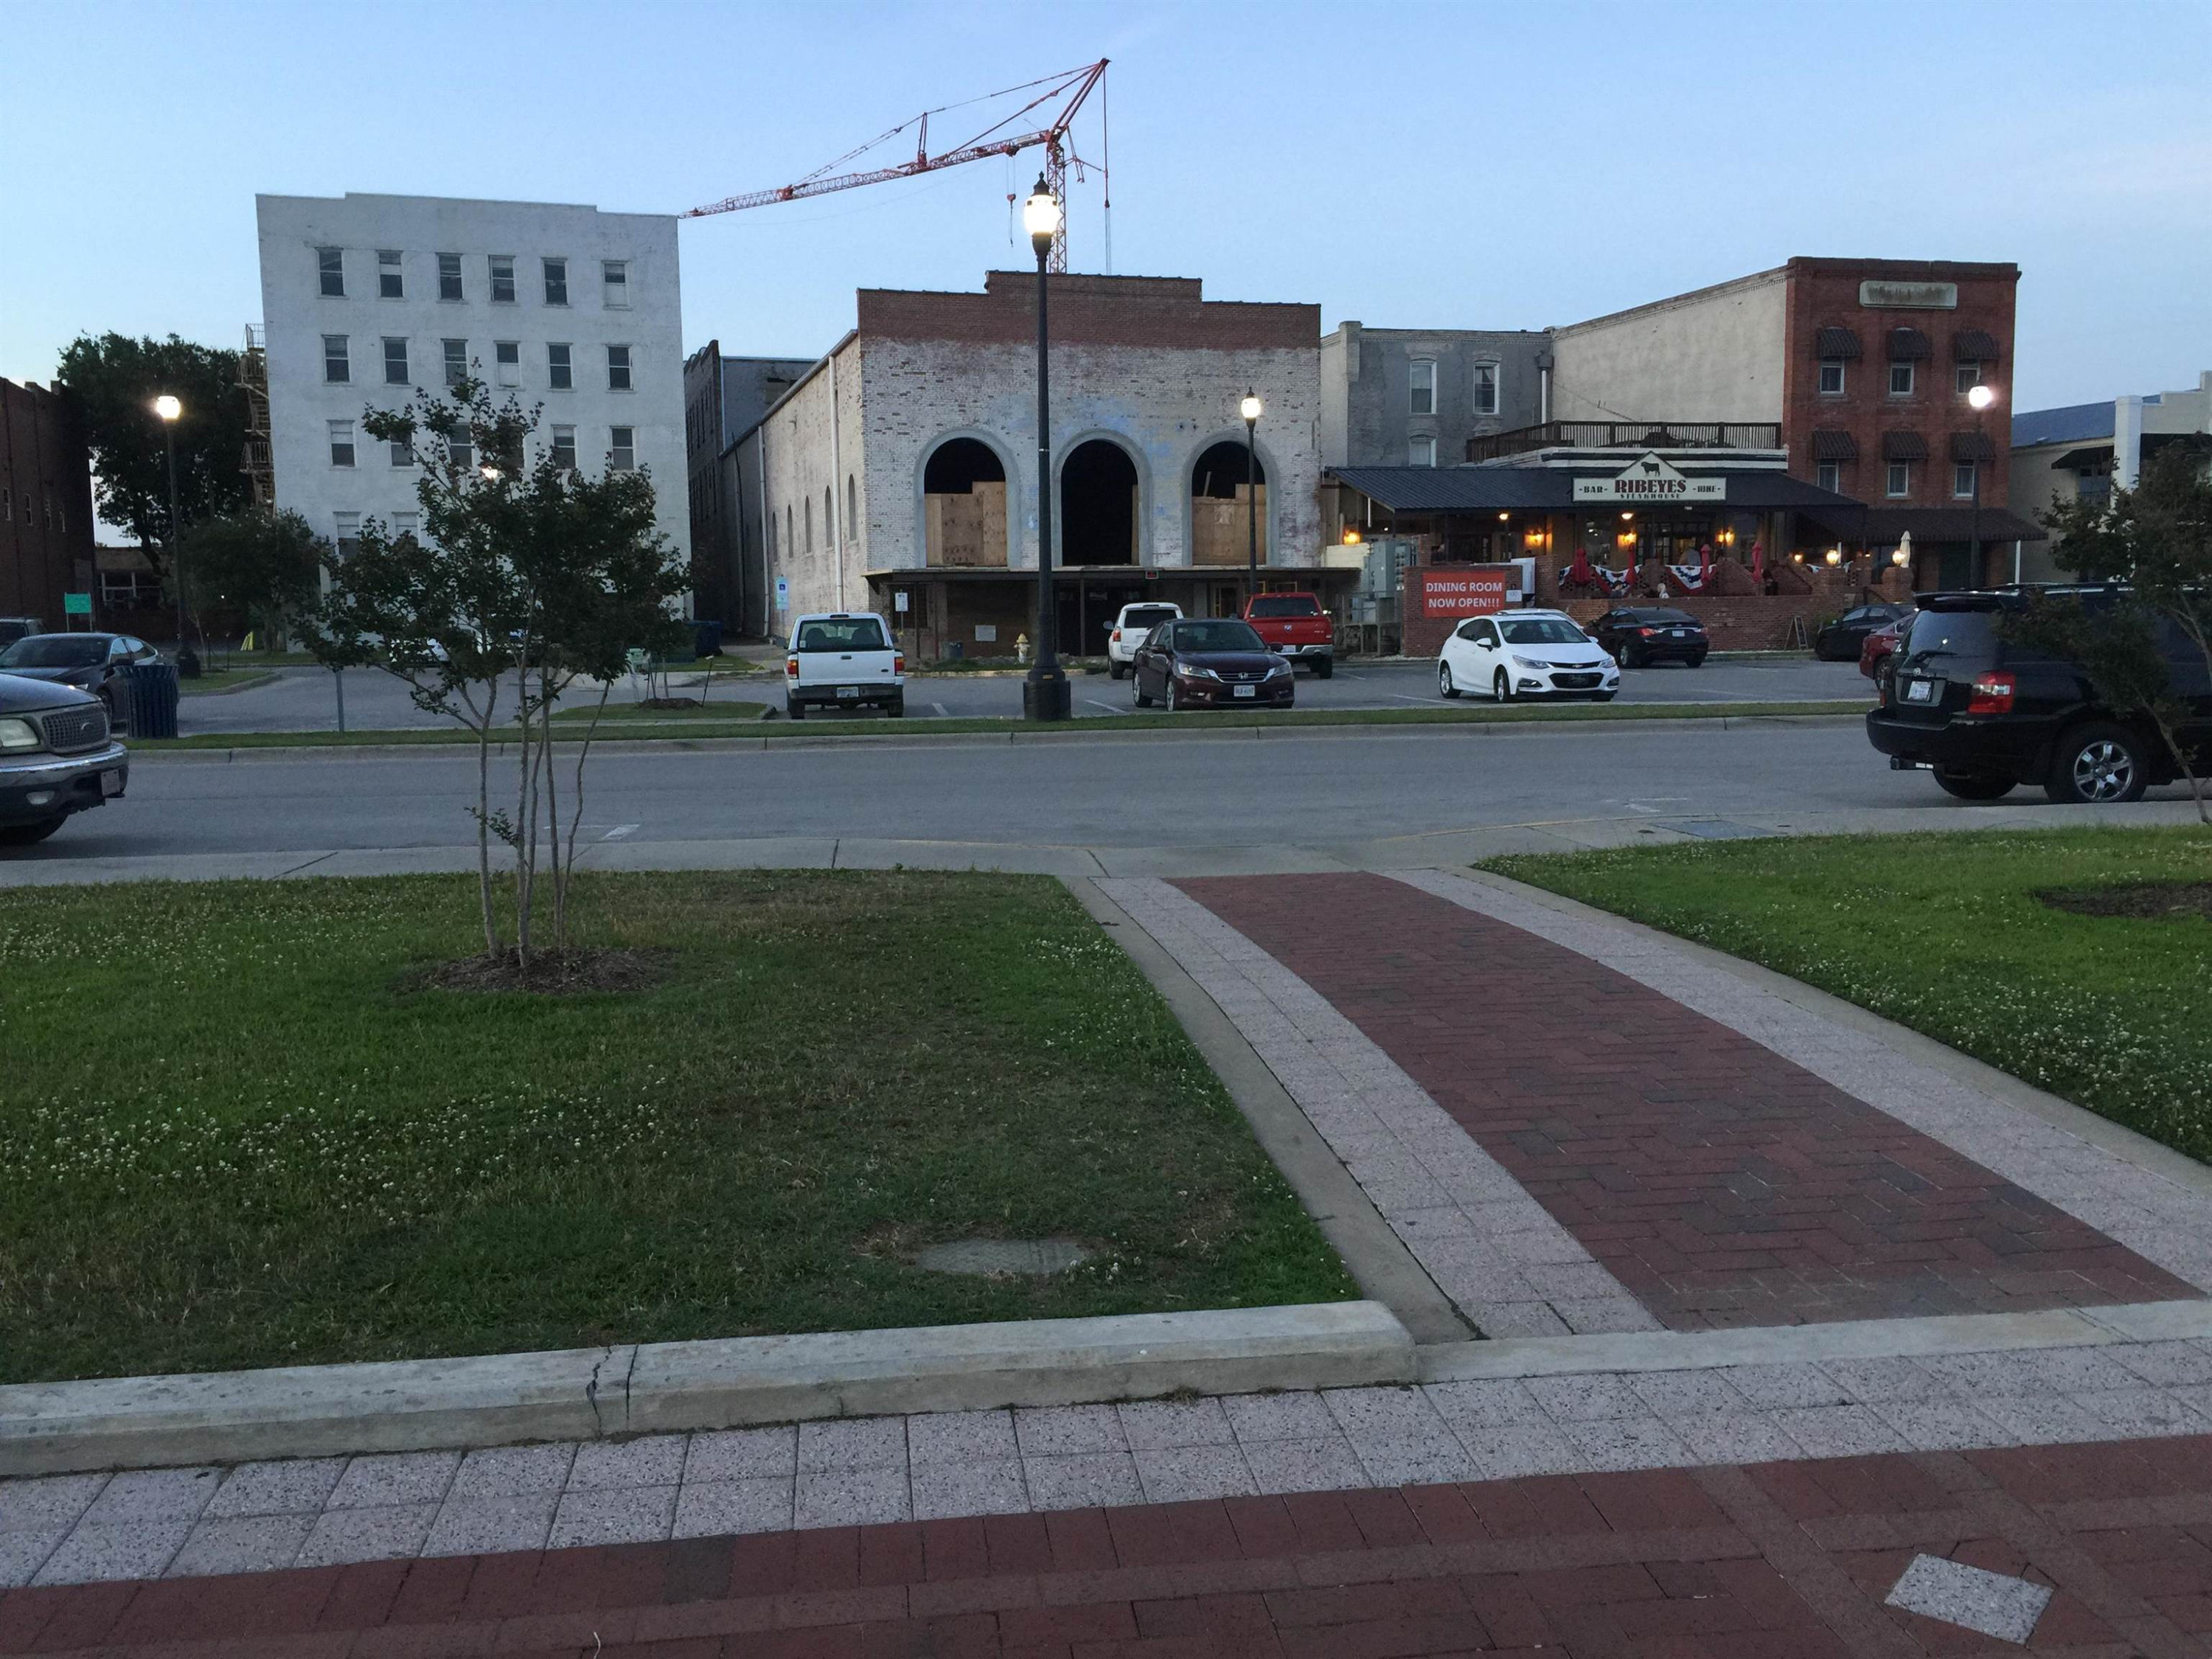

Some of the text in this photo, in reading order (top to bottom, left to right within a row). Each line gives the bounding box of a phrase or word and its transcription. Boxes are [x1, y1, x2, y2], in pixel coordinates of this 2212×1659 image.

[1614, 479, 1687, 493] RIBEYES
[1426, 582, 1503, 592] DINING ROOM
[1428, 598, 1500, 608] NOW OPEN!!!
